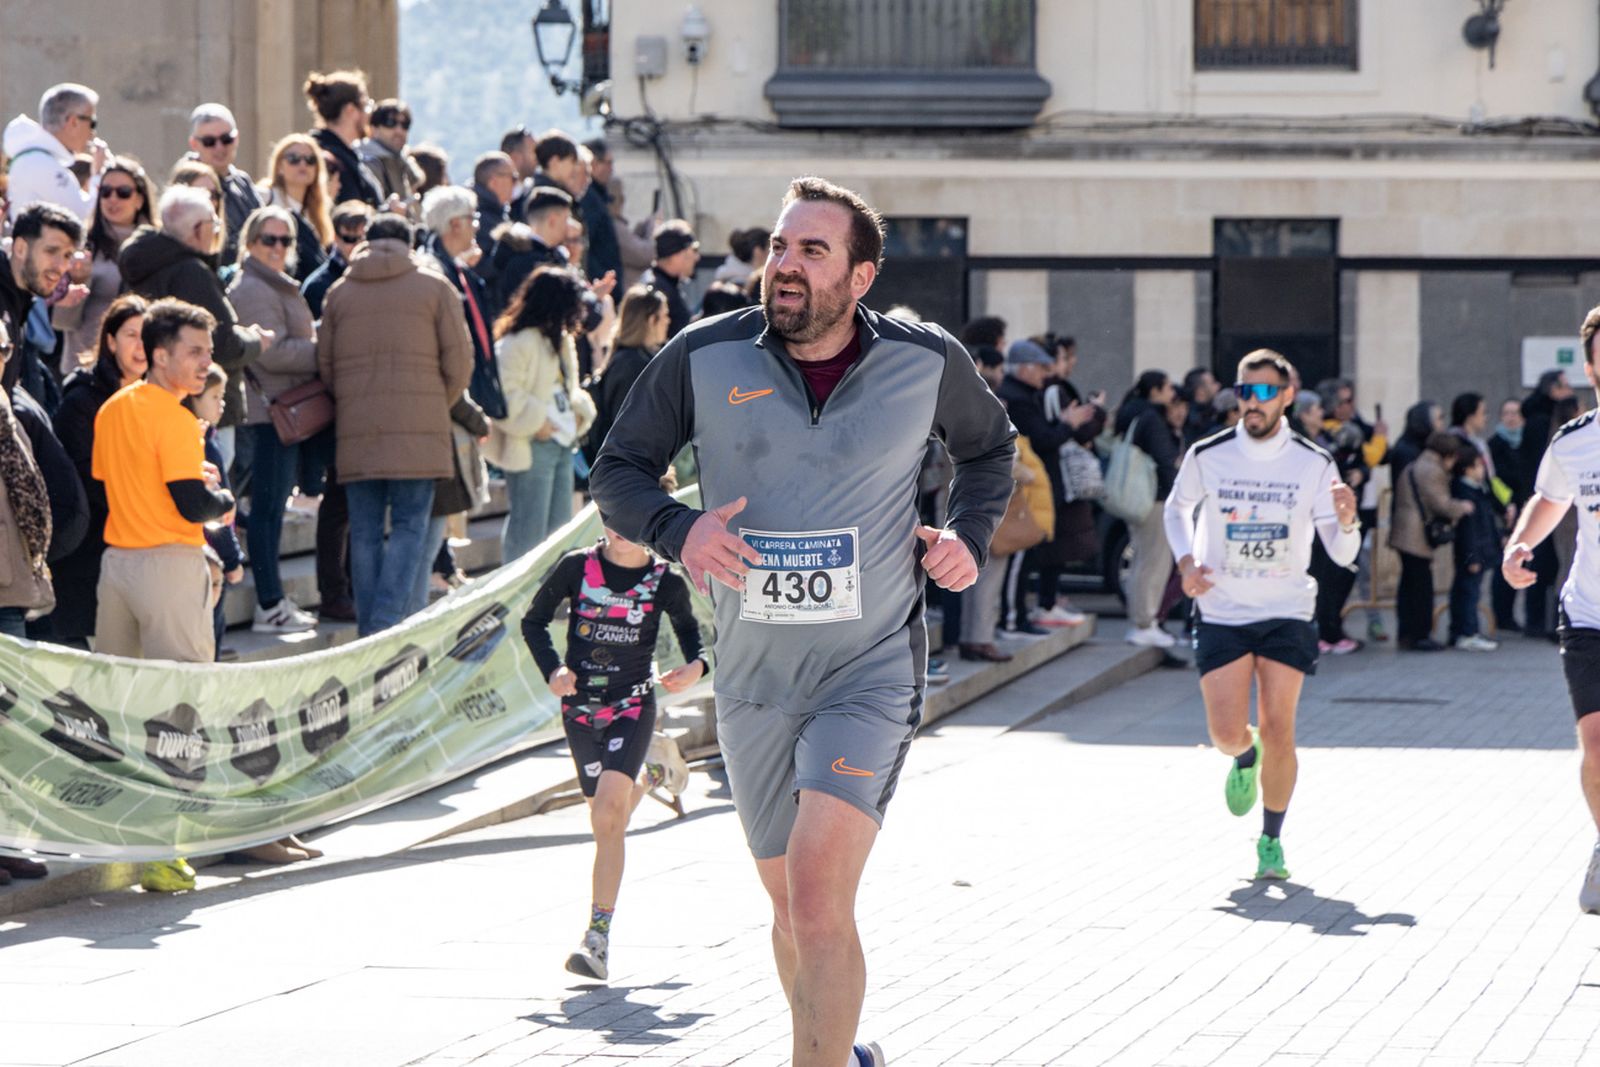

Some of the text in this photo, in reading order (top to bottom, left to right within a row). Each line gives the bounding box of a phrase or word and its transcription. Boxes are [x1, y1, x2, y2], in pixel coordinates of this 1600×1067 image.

[760, 540, 796, 550] CARRERA
[798, 538, 841, 550] CAMINATA
[1240, 540, 1276, 559] 465
[783, 553, 823, 567] MUERTE
[762, 570, 832, 604] 430
[595, 631, 640, 642] CANENA
